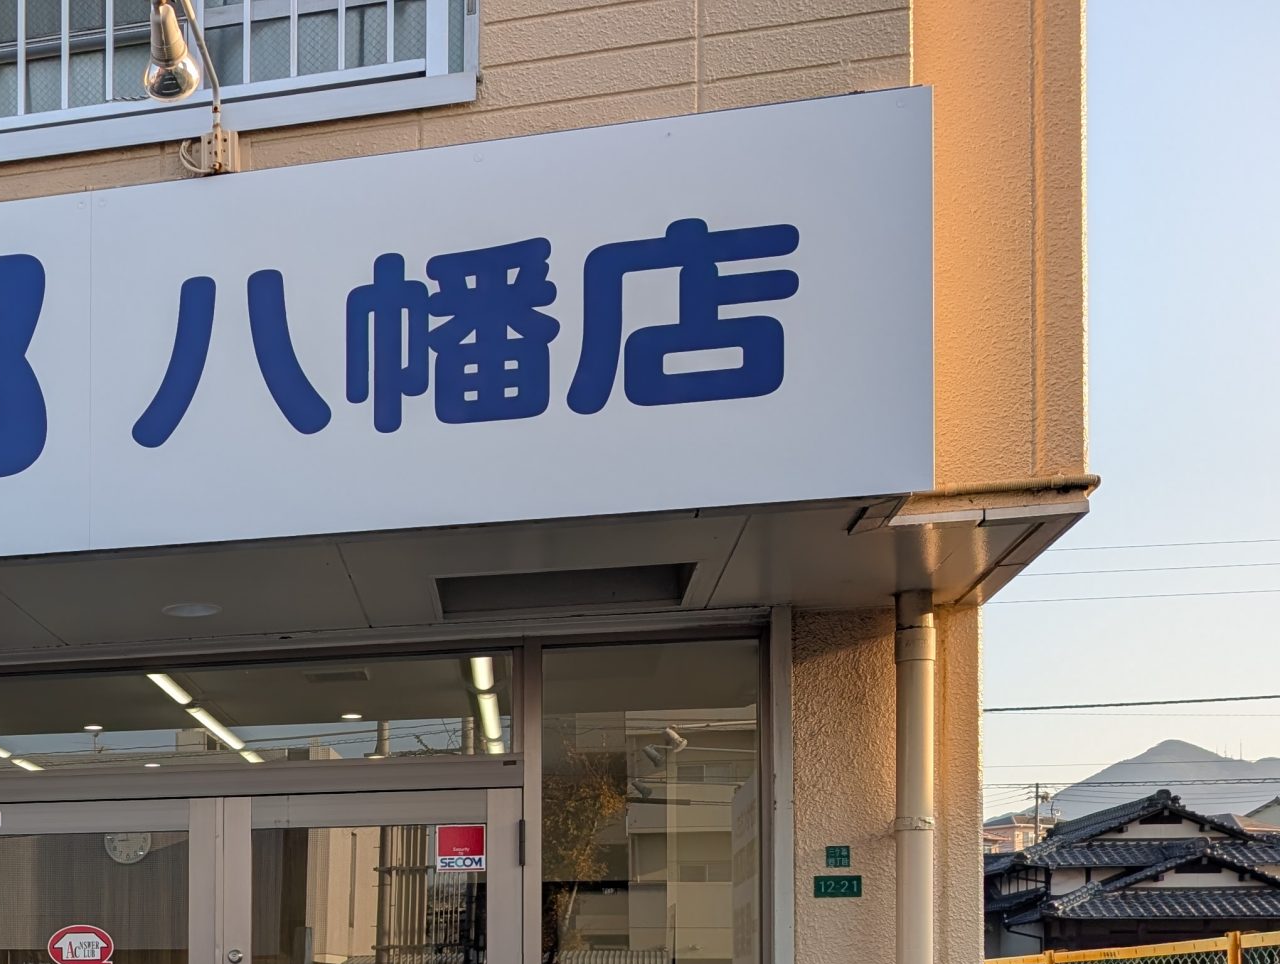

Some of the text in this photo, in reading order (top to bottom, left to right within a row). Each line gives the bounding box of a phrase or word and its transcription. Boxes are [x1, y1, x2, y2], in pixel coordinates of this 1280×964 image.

[132, 218, 799, 448] 八幡店
[440, 857, 482, 868] SECOM
[819, 880, 858, 893] 12-21
